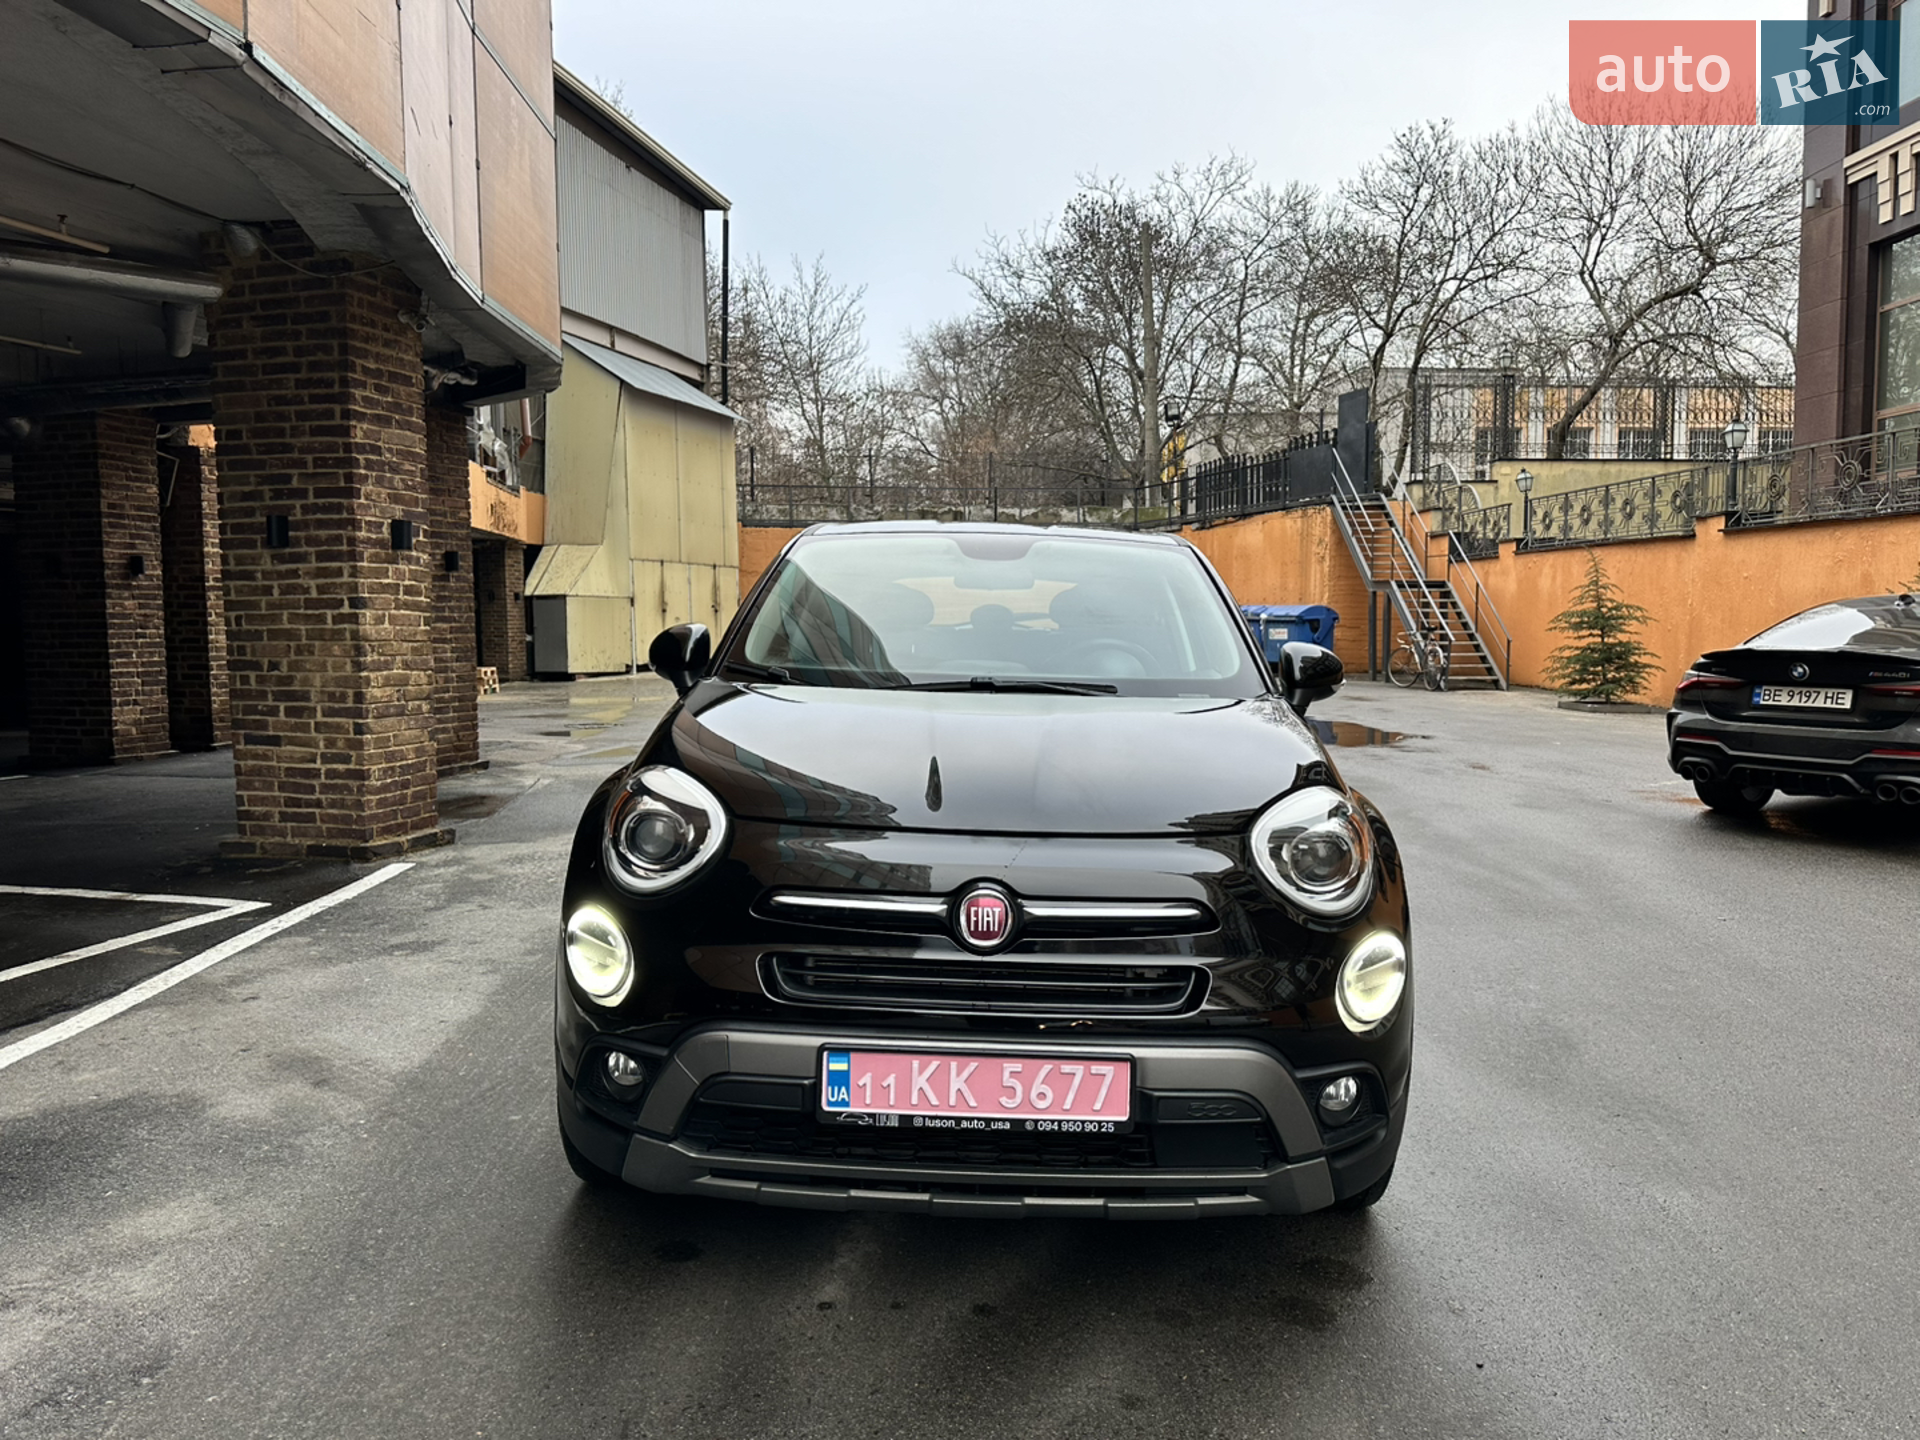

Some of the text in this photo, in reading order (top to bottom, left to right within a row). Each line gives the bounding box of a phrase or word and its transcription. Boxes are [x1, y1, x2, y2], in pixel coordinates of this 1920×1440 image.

[1762, 688, 1847, 706] BE 9197 HE
[970, 906, 1002, 932] FIAT
[828, 1085, 849, 1102] UA
[857, 1060, 1115, 1112] 11 KK 5677
[1188, 1102, 1237, 1117] 500
[1037, 1120, 1059, 1131] 094
[1061, 1121, 1082, 1132] 950
[1084, 1122, 1099, 1132] 90
[1101, 1122, 1115, 1133] 25
